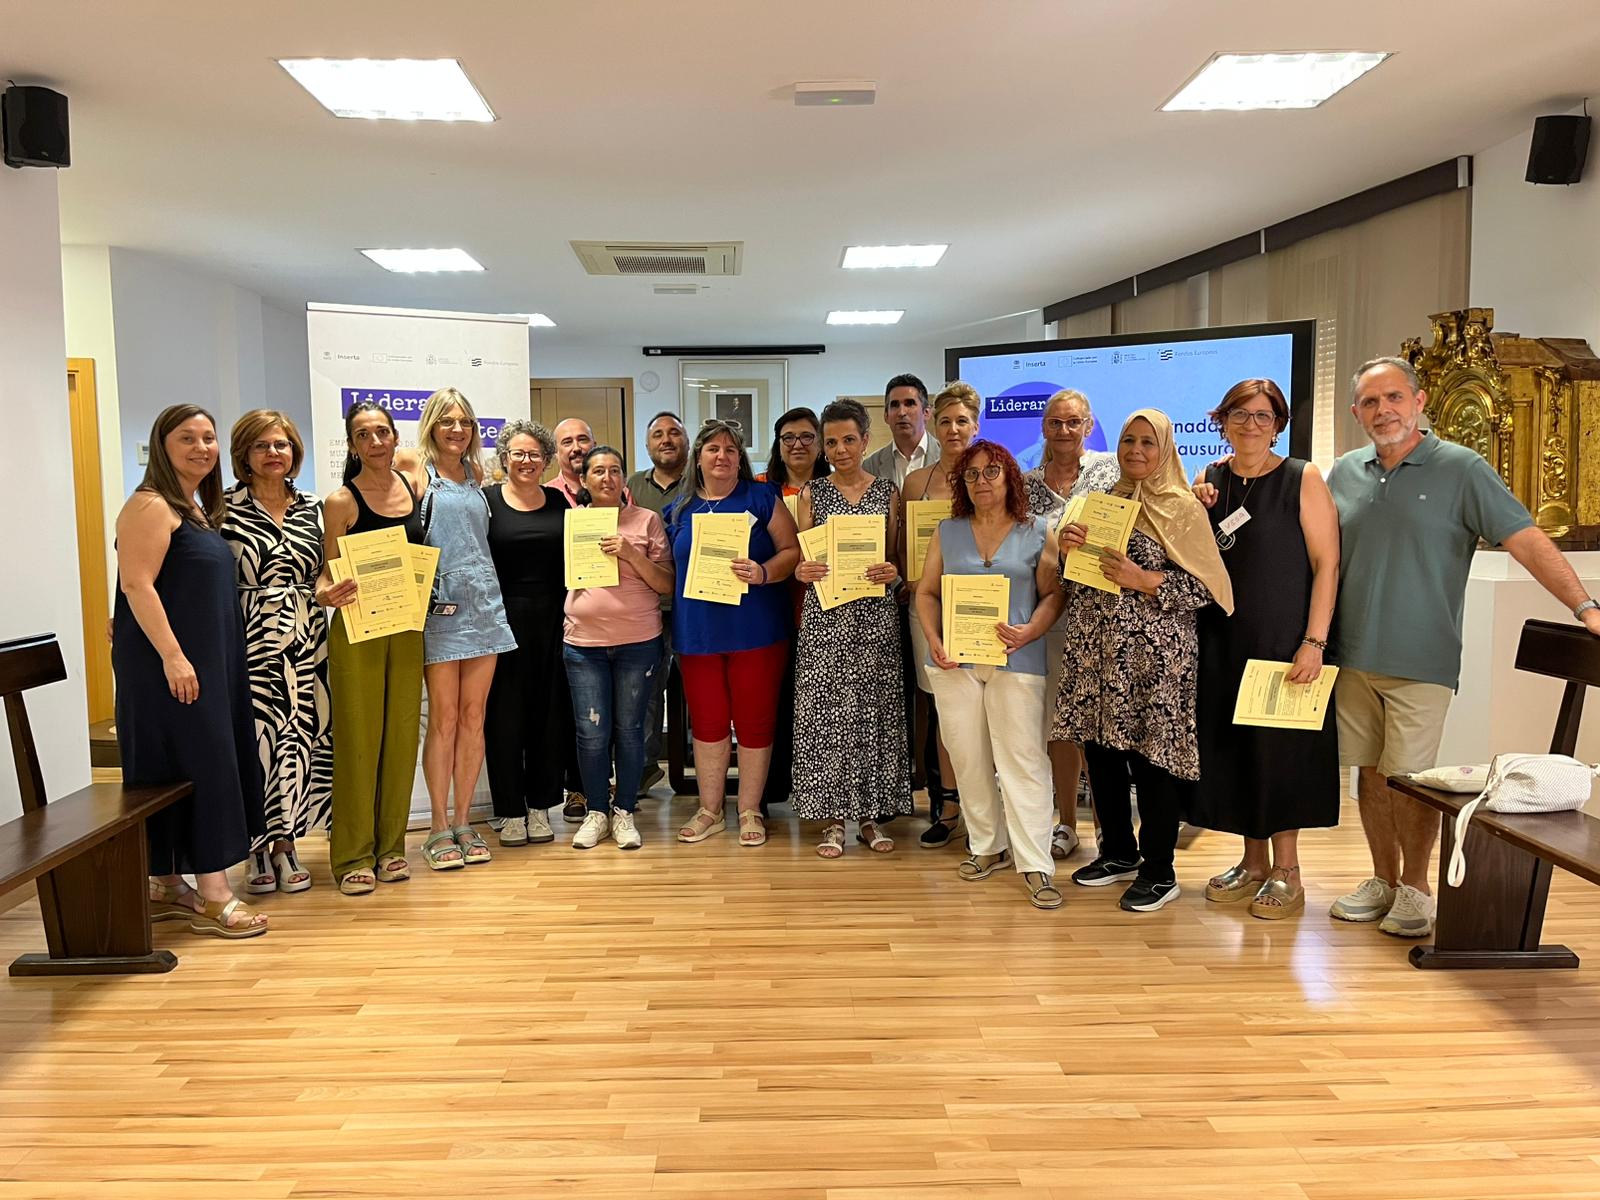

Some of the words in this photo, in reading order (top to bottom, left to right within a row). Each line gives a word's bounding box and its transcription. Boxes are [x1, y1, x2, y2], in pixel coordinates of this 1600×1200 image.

[1025, 360, 1046, 368] Inserta
[990, 398, 1046, 413] Liderar
[1174, 418, 1218, 434] nada
[1177, 444, 1235, 456] ausura
